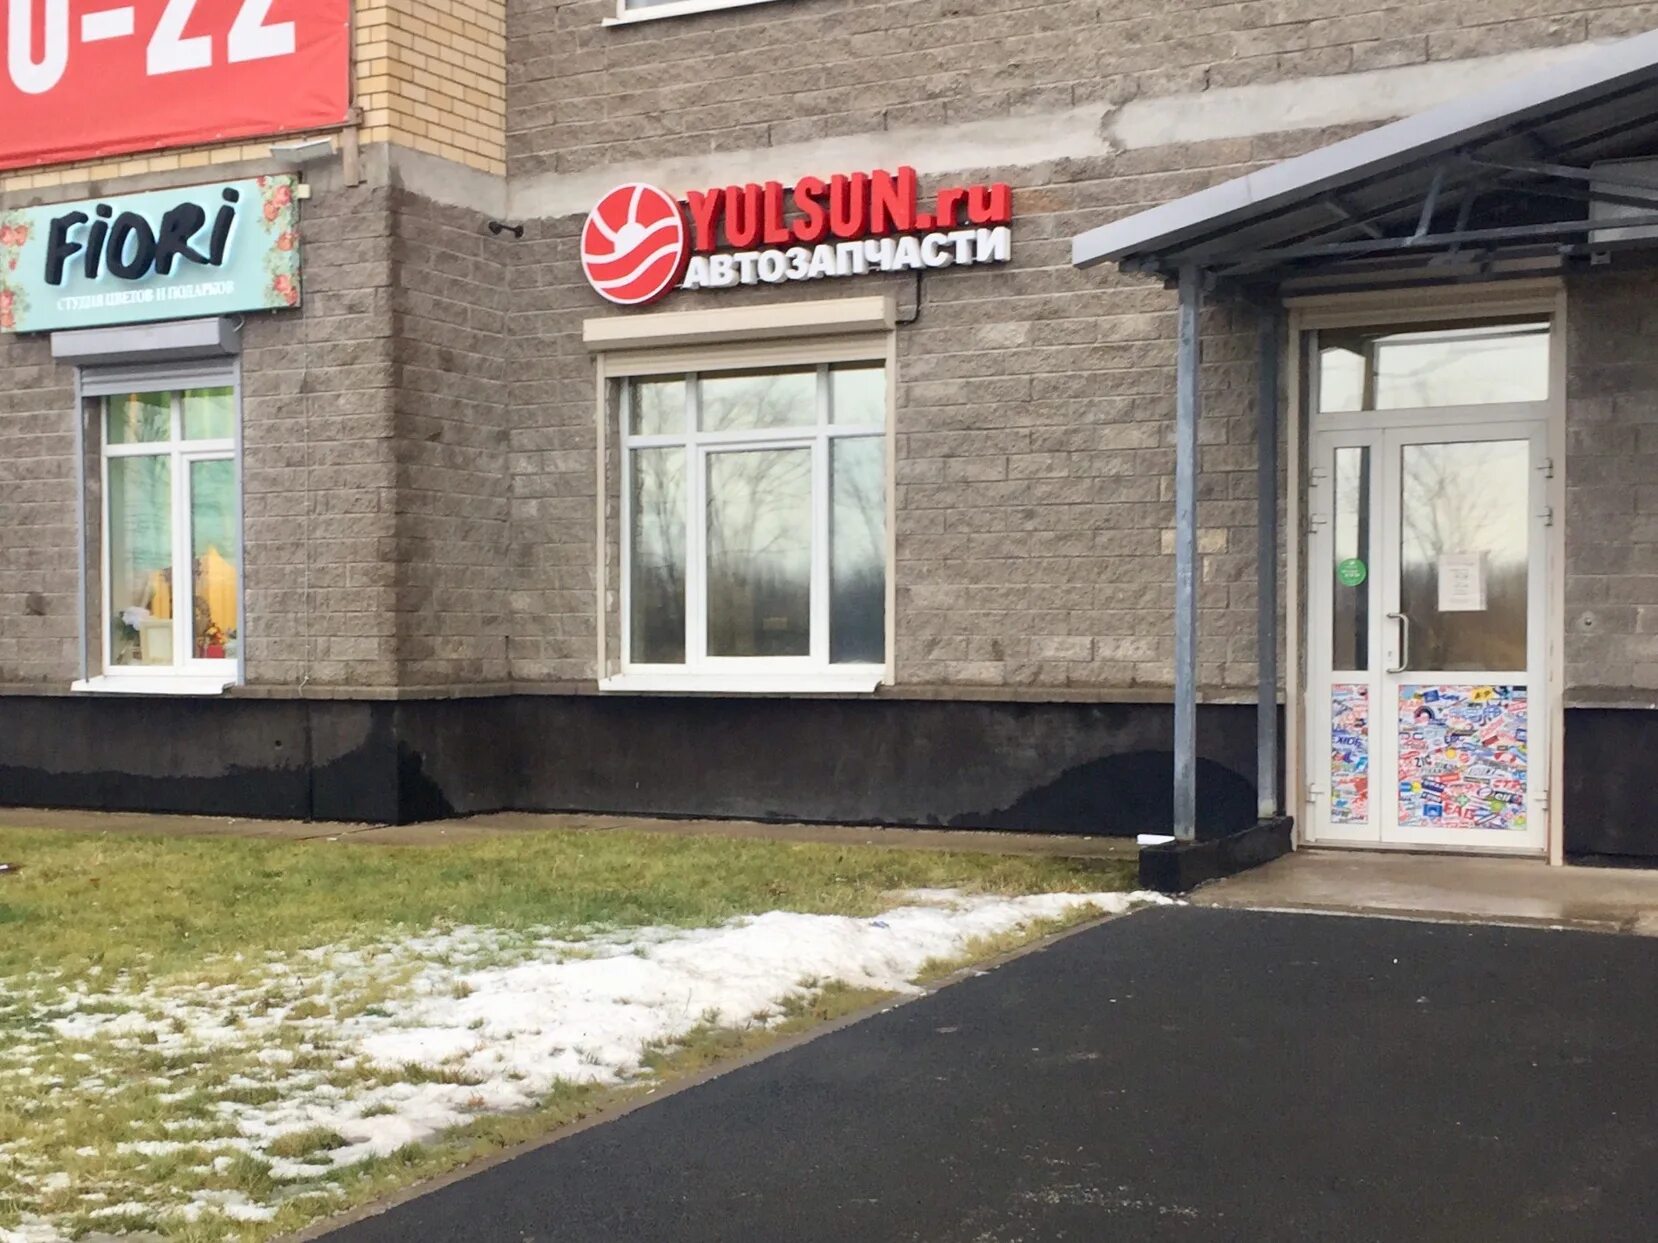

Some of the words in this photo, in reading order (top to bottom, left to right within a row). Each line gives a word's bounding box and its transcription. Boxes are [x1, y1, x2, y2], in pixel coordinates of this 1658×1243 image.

[687, 166, 1012, 253] YULSUN.ru
[680, 226, 1012, 290] АВТОЗАПЧАСТИ
[57, 294, 104, 311] СТУДИЯ
[104, 288, 154, 307] ЦВЕТОВ
[156, 286, 166, 301] И
[167, 280, 235, 300] ПОДАРКОВ
